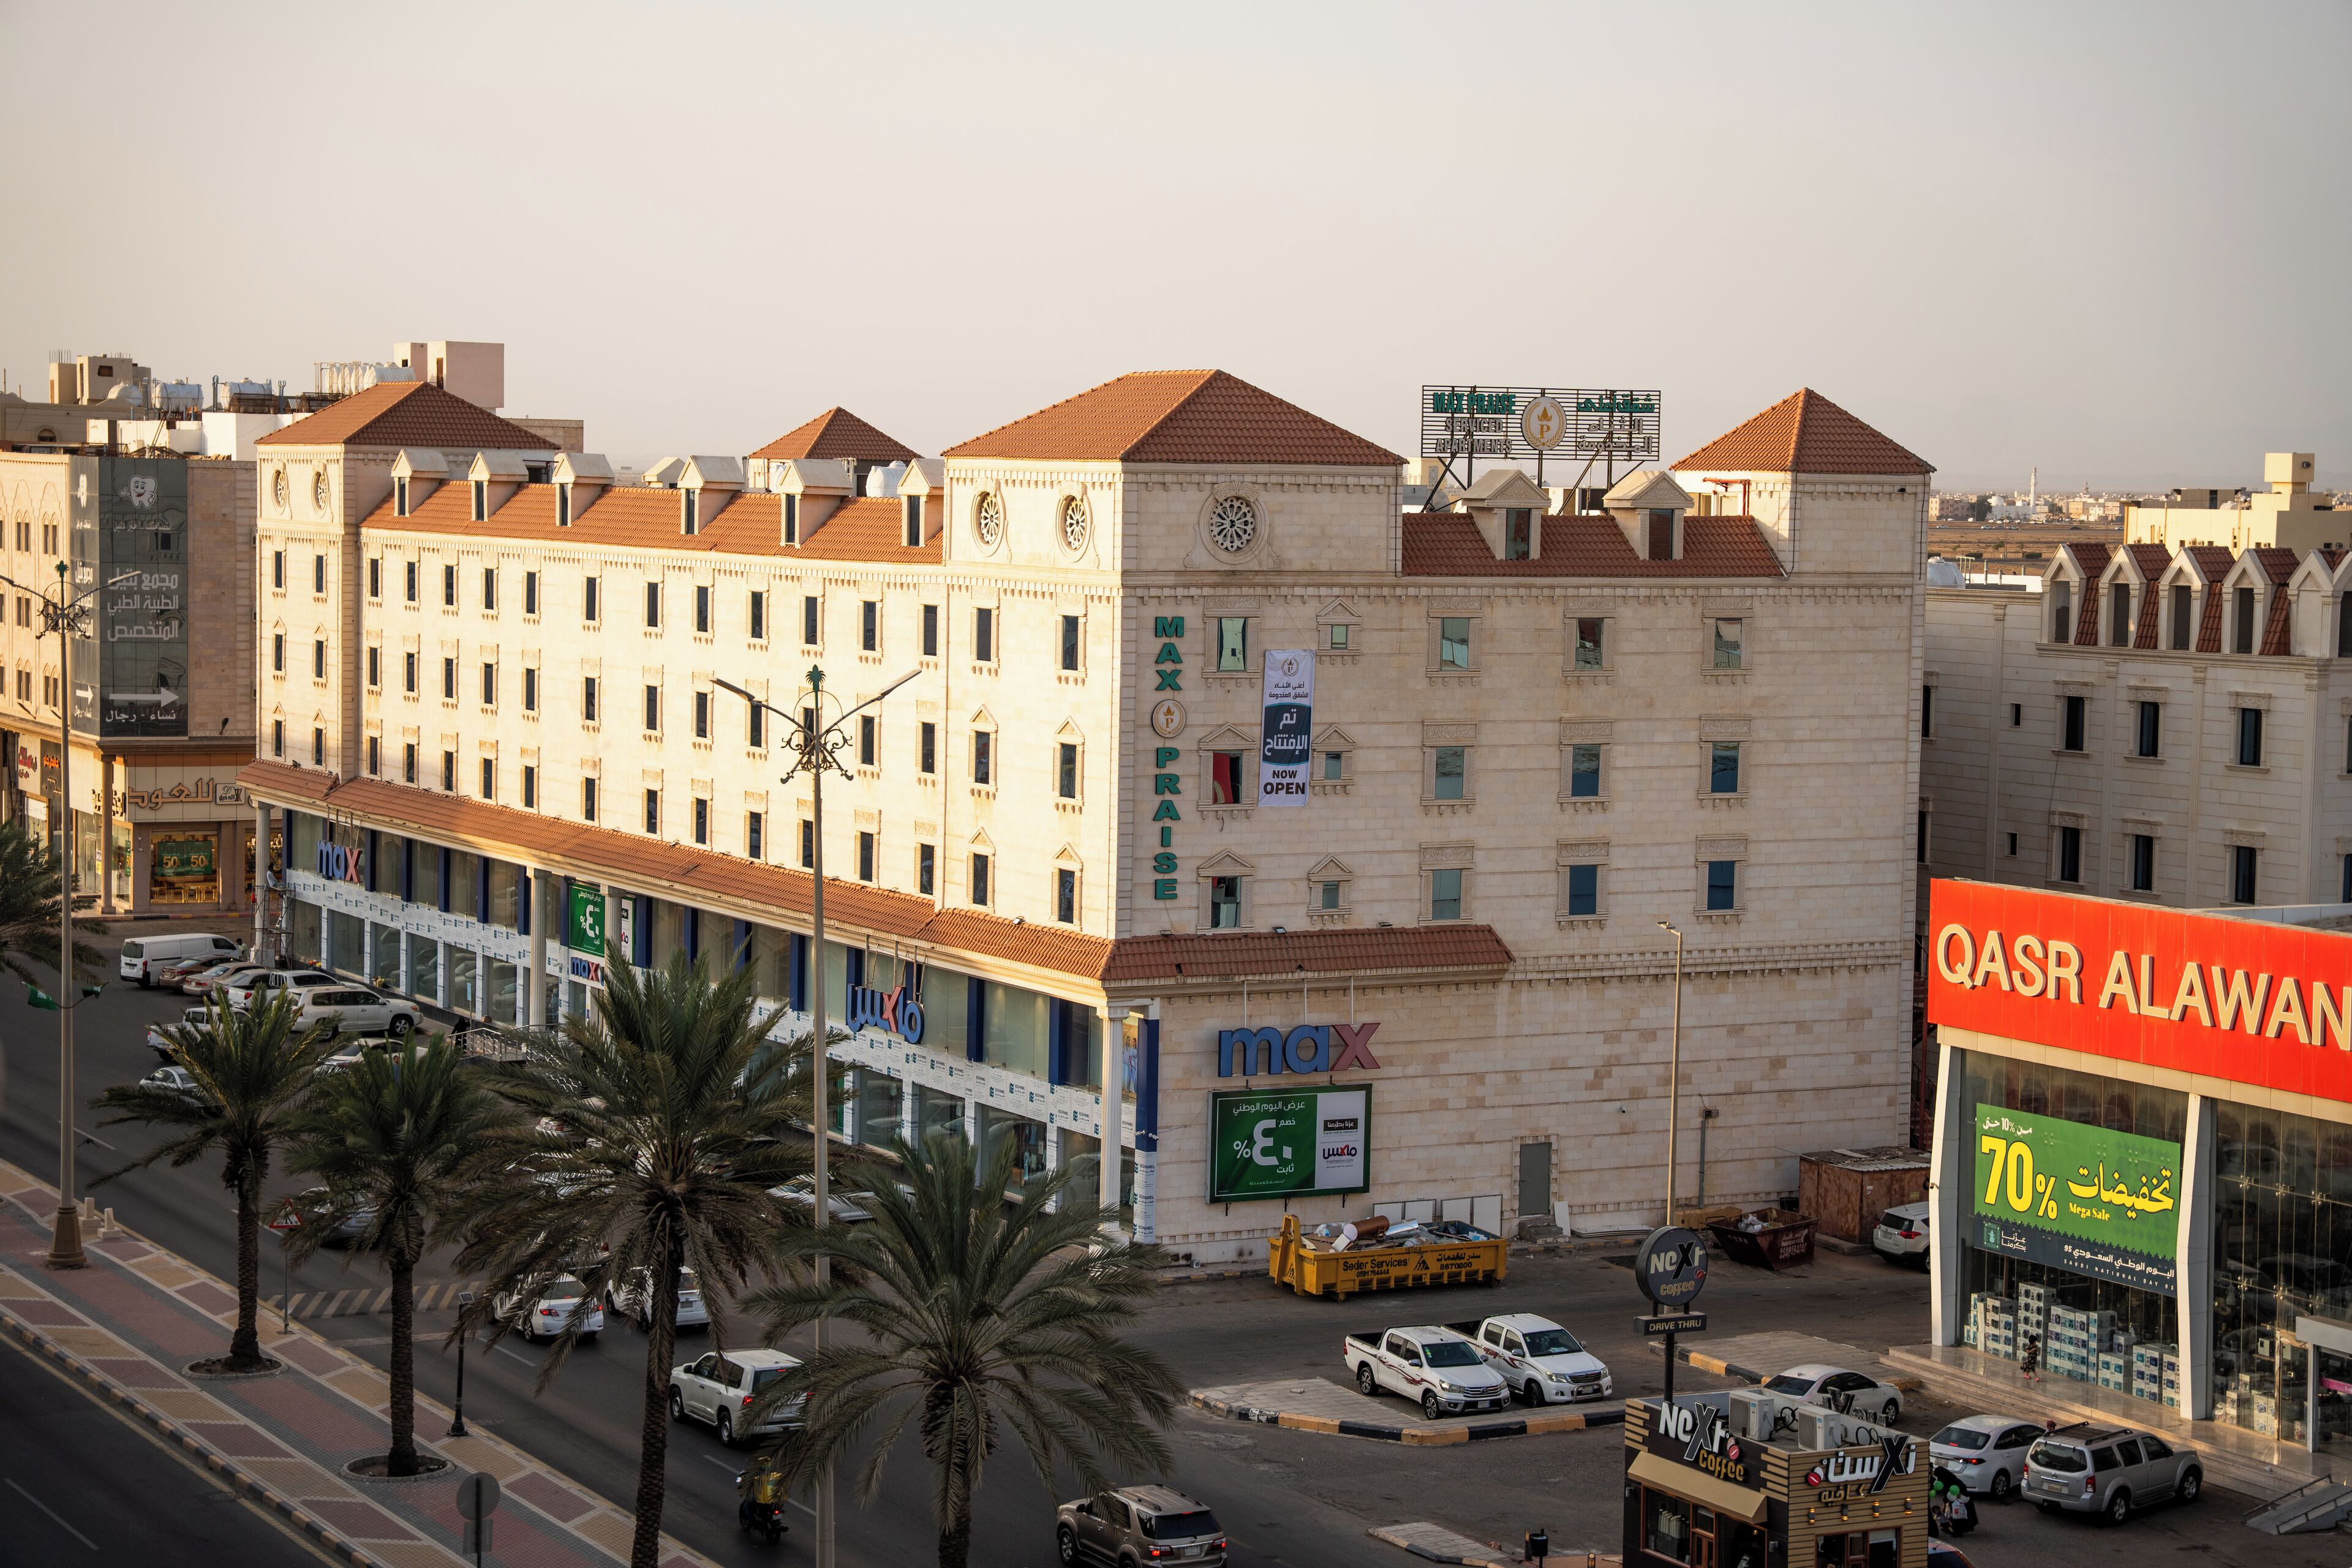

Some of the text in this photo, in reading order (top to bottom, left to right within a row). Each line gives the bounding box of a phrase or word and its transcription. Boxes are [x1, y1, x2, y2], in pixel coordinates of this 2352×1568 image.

[1433, 392, 1516, 415] MAX PRAISE
[1445, 417, 1503, 432] SERVICED
[1435, 437, 1512, 453] APARTMENTS
[1578, 435, 1653, 454] المخدومة
[141, 574, 178, 590] مجمع
[107, 594, 140, 616] الطبي
[143, 595, 178, 612] الطبية
[107, 620, 178, 642] المتخصص
[1155, 616, 1184, 691] MAX
[105, 710, 136, 723] رجال
[150, 710, 176, 721] نساء
[1279, 708, 1297, 730] تم
[1272, 769, 1298, 780] NOW
[1263, 782, 1306, 795] OPEN
[1152, 747, 1182, 900] PRAISE
[317, 840, 363, 883] max
[571, 957, 600, 982] max
[1937, 924, 2352, 1052] QASR ALAWAN
[1218, 1022, 1381, 1078] max
[1233, 1101, 1305, 1115] عرض اليوم الوطني
[1276, 1163, 1294, 1174] ثابت
[1980, 1134, 2058, 1220] 70%
[2067, 1160, 2174, 1221] تخفيضات
[2069, 1202, 2110, 1221] Mega Sale
[2073, 1249, 2113, 1263] السعودي
[2114, 1257, 2145, 1270] الوطني
[1343, 1259, 1408, 1272] Seder Services
[1356, 1269, 1390, 1278] 0591754444
[1440, 1262, 1472, 1270] 8670000
[2064, 1259, 2089, 1269] SAUDI
[2095, 1267, 2137, 1281] NATIONAL
[2143, 1278, 2158, 1287] DAY
[2146, 1267, 2174, 1279] اليوم
[1649, 1319, 1702, 1332] DRIVE THRU
